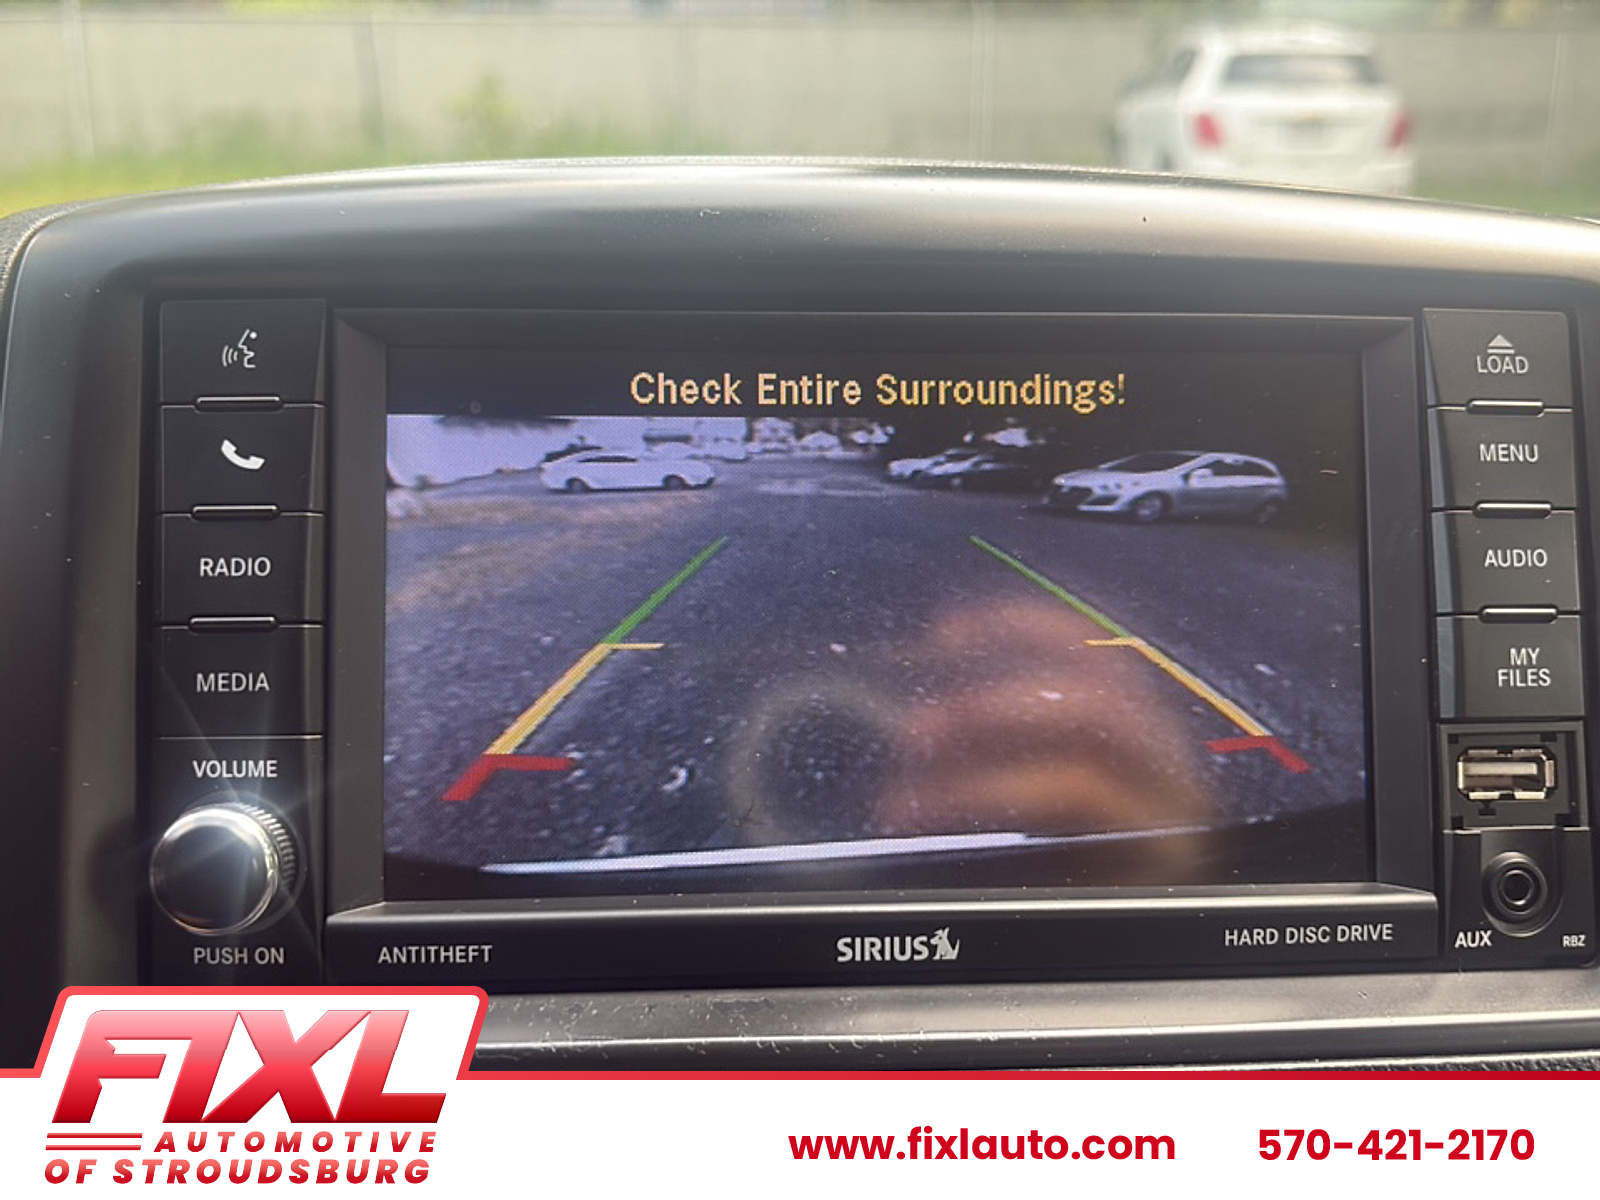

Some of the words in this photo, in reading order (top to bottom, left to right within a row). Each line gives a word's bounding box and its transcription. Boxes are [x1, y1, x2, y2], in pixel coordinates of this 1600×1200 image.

[1476, 354, 1529, 374] LOAD
[630, 372, 742, 405] Check
[758, 373, 862, 405] Entire
[876, 373, 1125, 414] Surroundings!
[1479, 443, 1539, 463] MENU
[199, 556, 271, 577] RADIO
[1484, 548, 1548, 568] AUDIO
[1510, 647, 1540, 666] MY
[196, 672, 270, 692] MEDIA
[1497, 668, 1551, 687] FILES
[192, 759, 278, 779] VOLUME
[1224, 928, 1279, 946] HARD
[1285, 925, 1331, 945] DISC
[1337, 923, 1393, 942] DRIVE
[1454, 929, 1492, 948] AUX
[1562, 934, 1586, 948] RBZ
[193, 946, 249, 965] PUSH
[254, 946, 284, 965] ON
[378, 944, 493, 964] ANTITHEFT
[836, 936, 930, 962] SIRIUS
